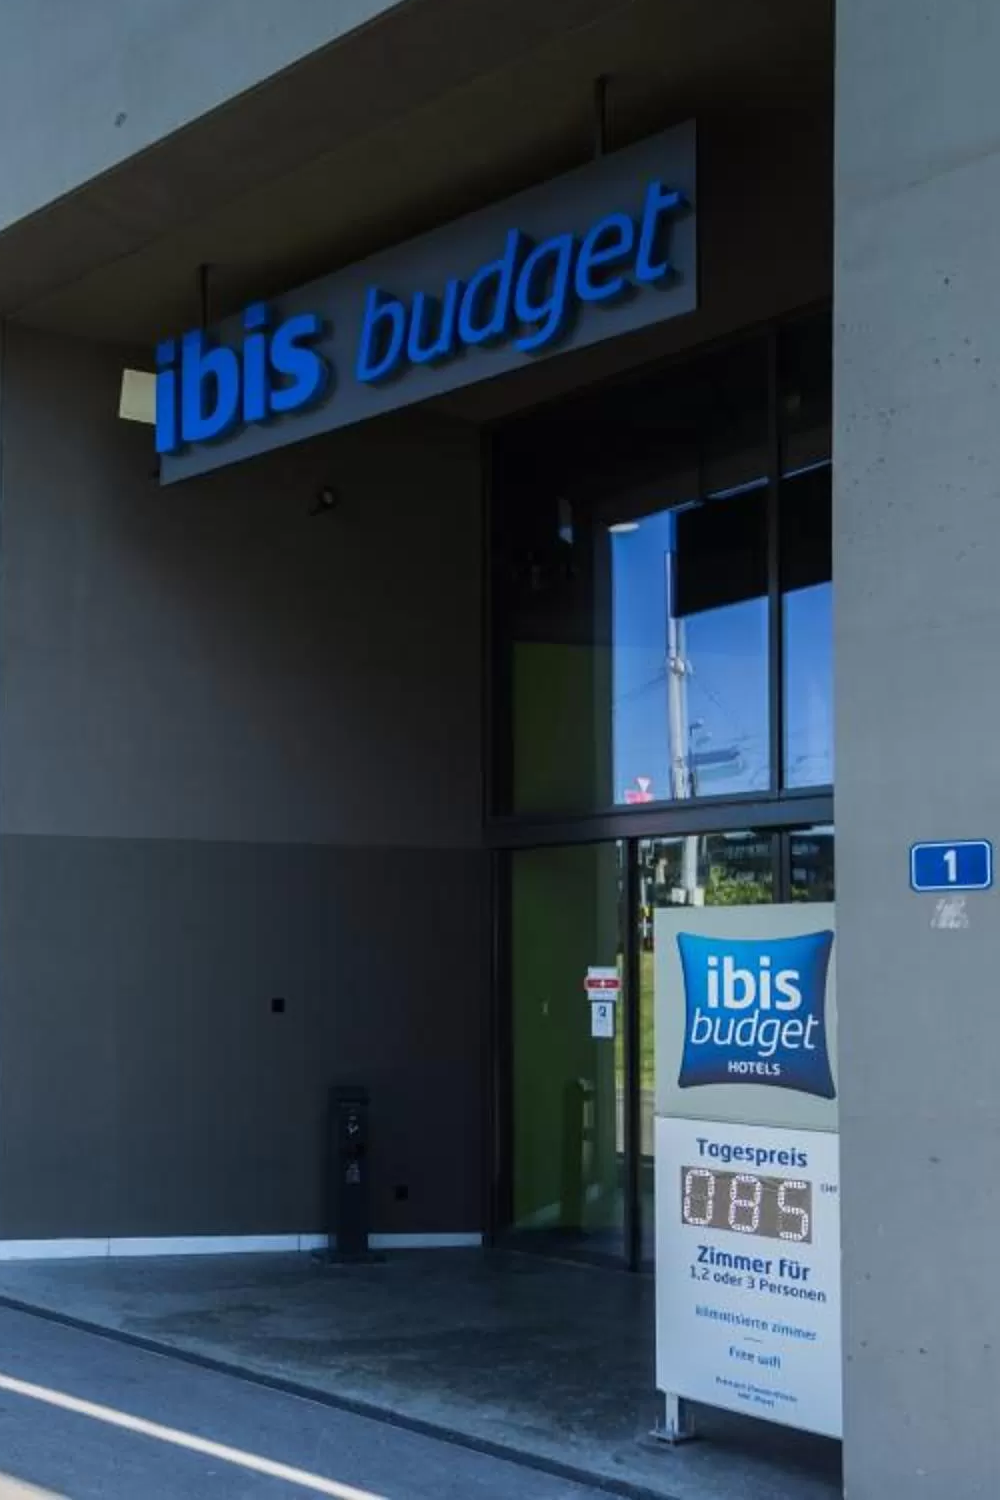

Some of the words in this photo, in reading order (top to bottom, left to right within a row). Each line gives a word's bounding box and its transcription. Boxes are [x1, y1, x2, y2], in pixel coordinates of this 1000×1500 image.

[155, 302, 327, 454] ibis
[354, 178, 686, 385] budget
[943, 849, 957, 882] 1
[707, 955, 802, 1011] ibis
[690, 1007, 819, 1057] budget
[727, 1060, 781, 1077] HOTELS
[696, 1138, 808, 1167] Tagespreis
[683, 1168, 809, 1241] 085
[697, 1245, 773, 1275] Zimmer
[779, 1258, 811, 1281] für
[713, 1271, 743, 1287] oder
[747, 1275, 755, 1289] 3
[759, 1277, 827, 1303] Personen
